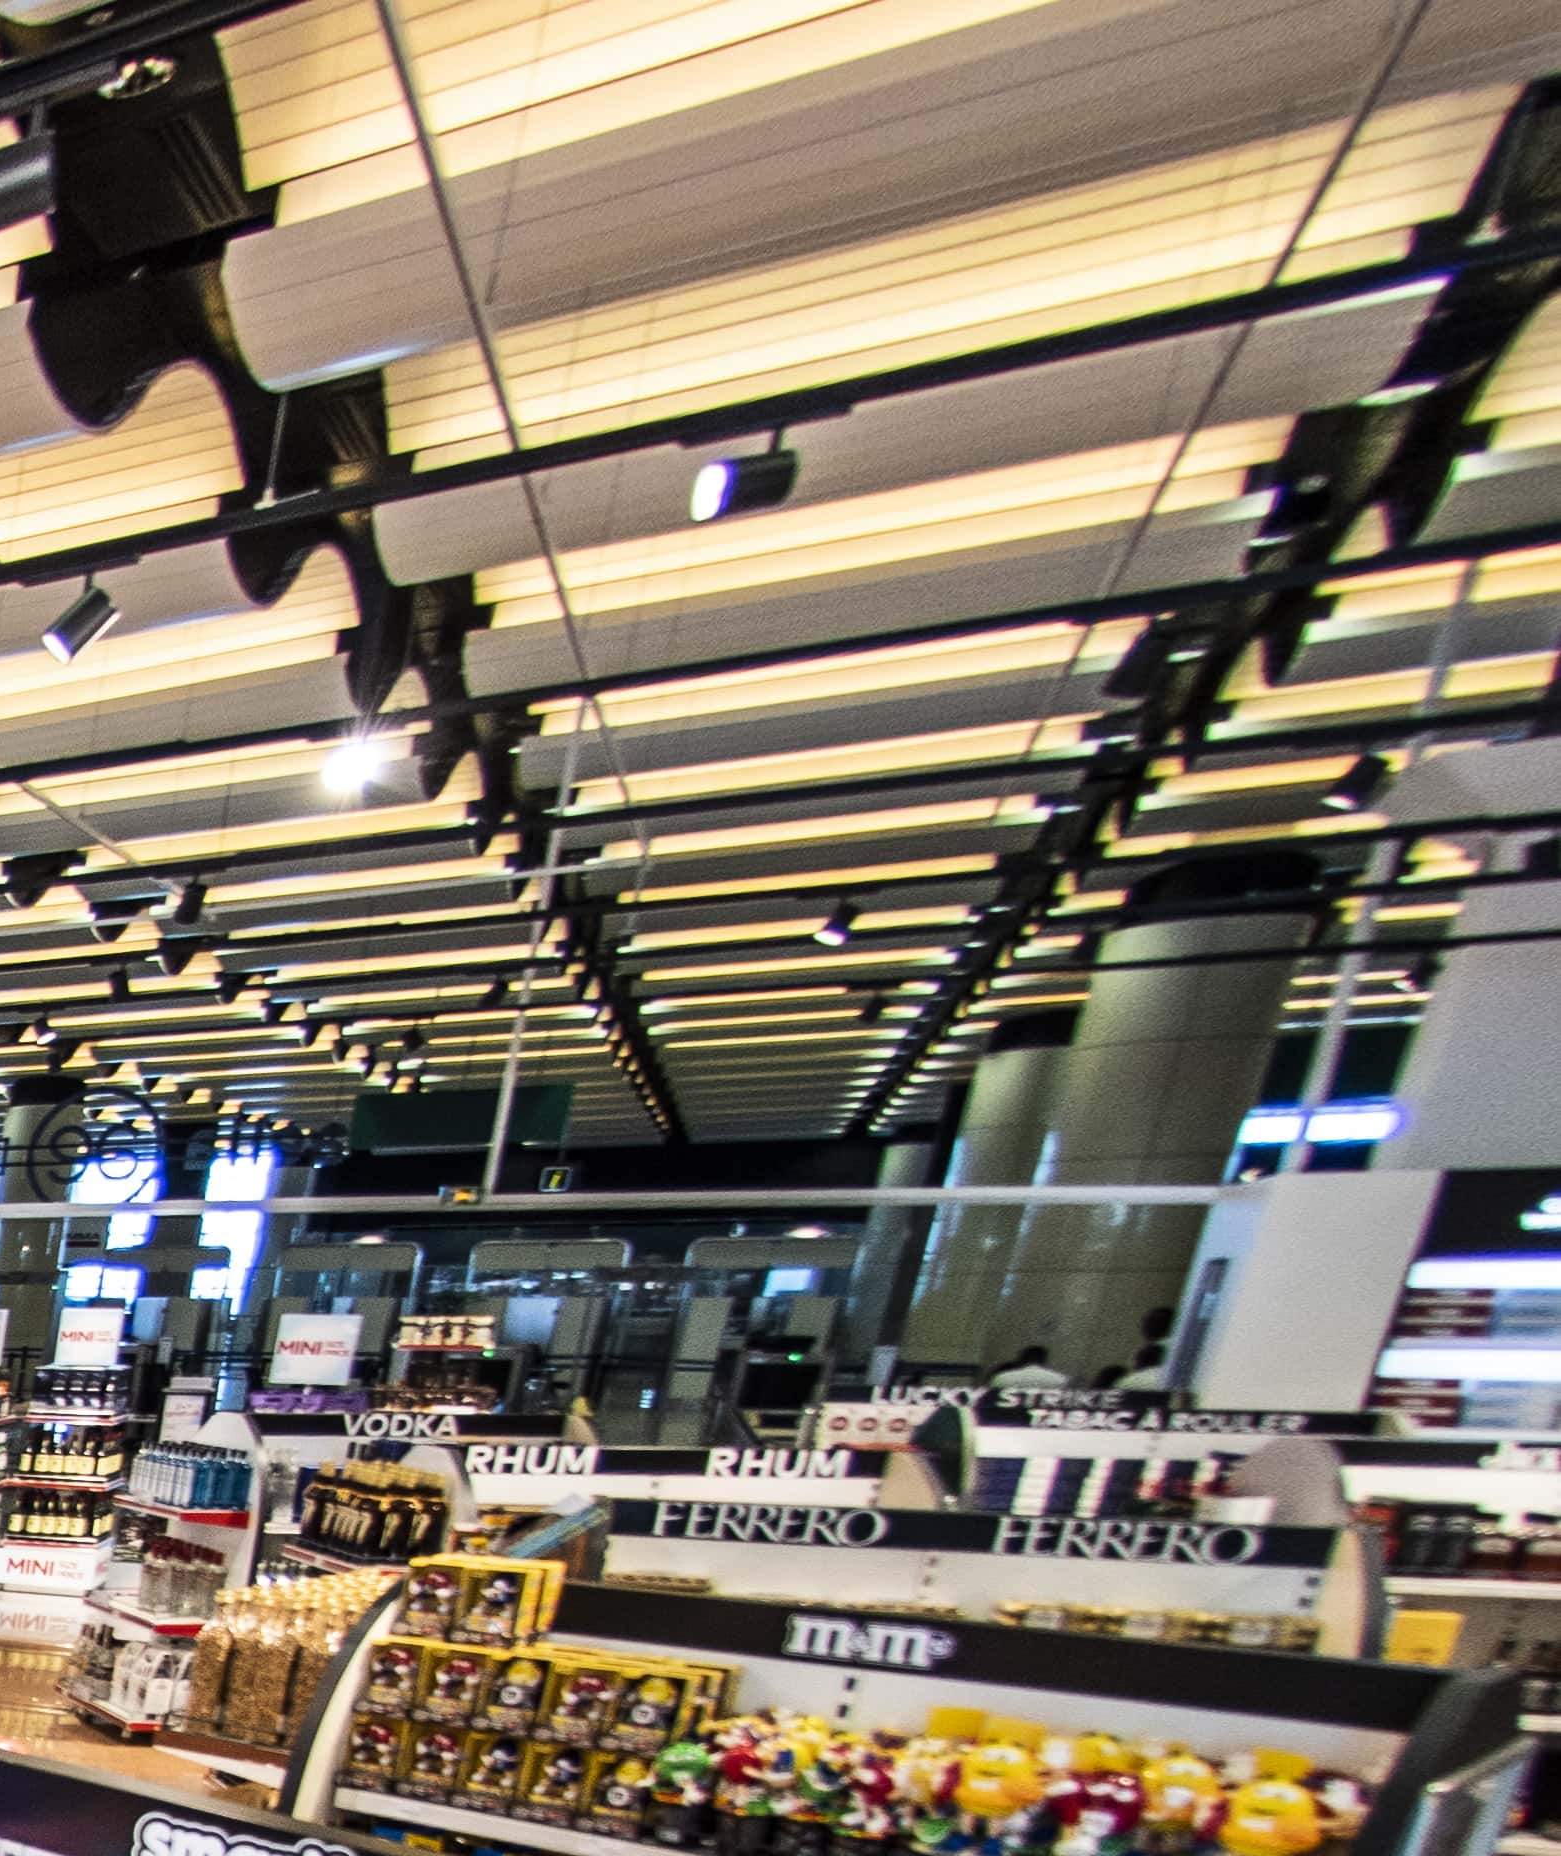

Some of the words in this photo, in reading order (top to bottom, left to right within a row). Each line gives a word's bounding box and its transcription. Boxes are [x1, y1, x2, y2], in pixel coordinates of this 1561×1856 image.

[61, 1330, 93, 1342] MINI
[277, 1341, 323, 1355] MINI
[871, 1385, 987, 1408] LUCKY
[997, 1389, 1124, 1409] STRIKE
[344, 1413, 459, 1438] VODKA
[1029, 1408, 1136, 1431] TABAC
[1169, 1413, 1309, 1435] ROULER
[466, 1445, 600, 1475] RHUM
[706, 1449, 854, 1478] RHUM
[653, 1501, 886, 1547] FERRERO
[993, 1516, 1264, 1566] FERRERO
[7, 1557, 55, 1577] MINI
